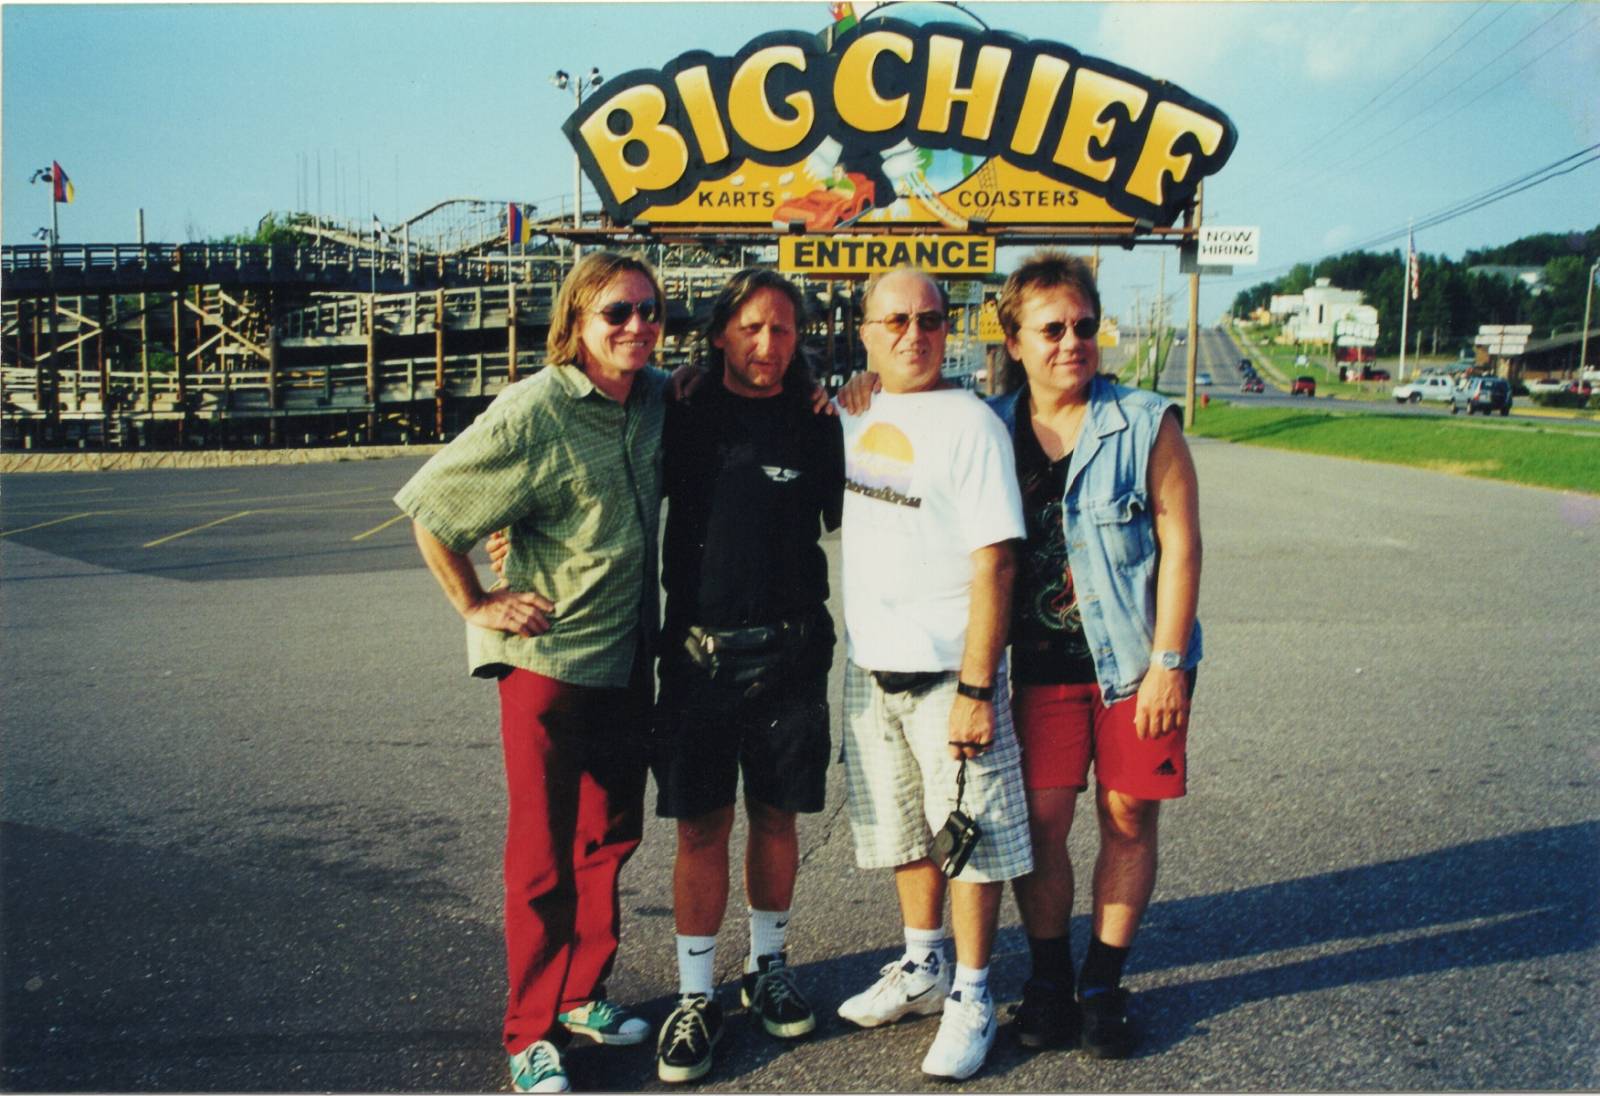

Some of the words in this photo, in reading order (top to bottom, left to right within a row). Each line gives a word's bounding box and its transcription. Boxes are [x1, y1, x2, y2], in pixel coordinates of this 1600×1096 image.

[579, 45, 815, 204] BIG
[833, 31, 1223, 208] CHIEF
[698, 191, 776, 208] KARTS
[958, 190, 1080, 208] COASTERS
[1207, 231, 1252, 242] NOW
[794, 241, 989, 268] ENTRANCE
[1202, 245, 1254, 255] HIRING
